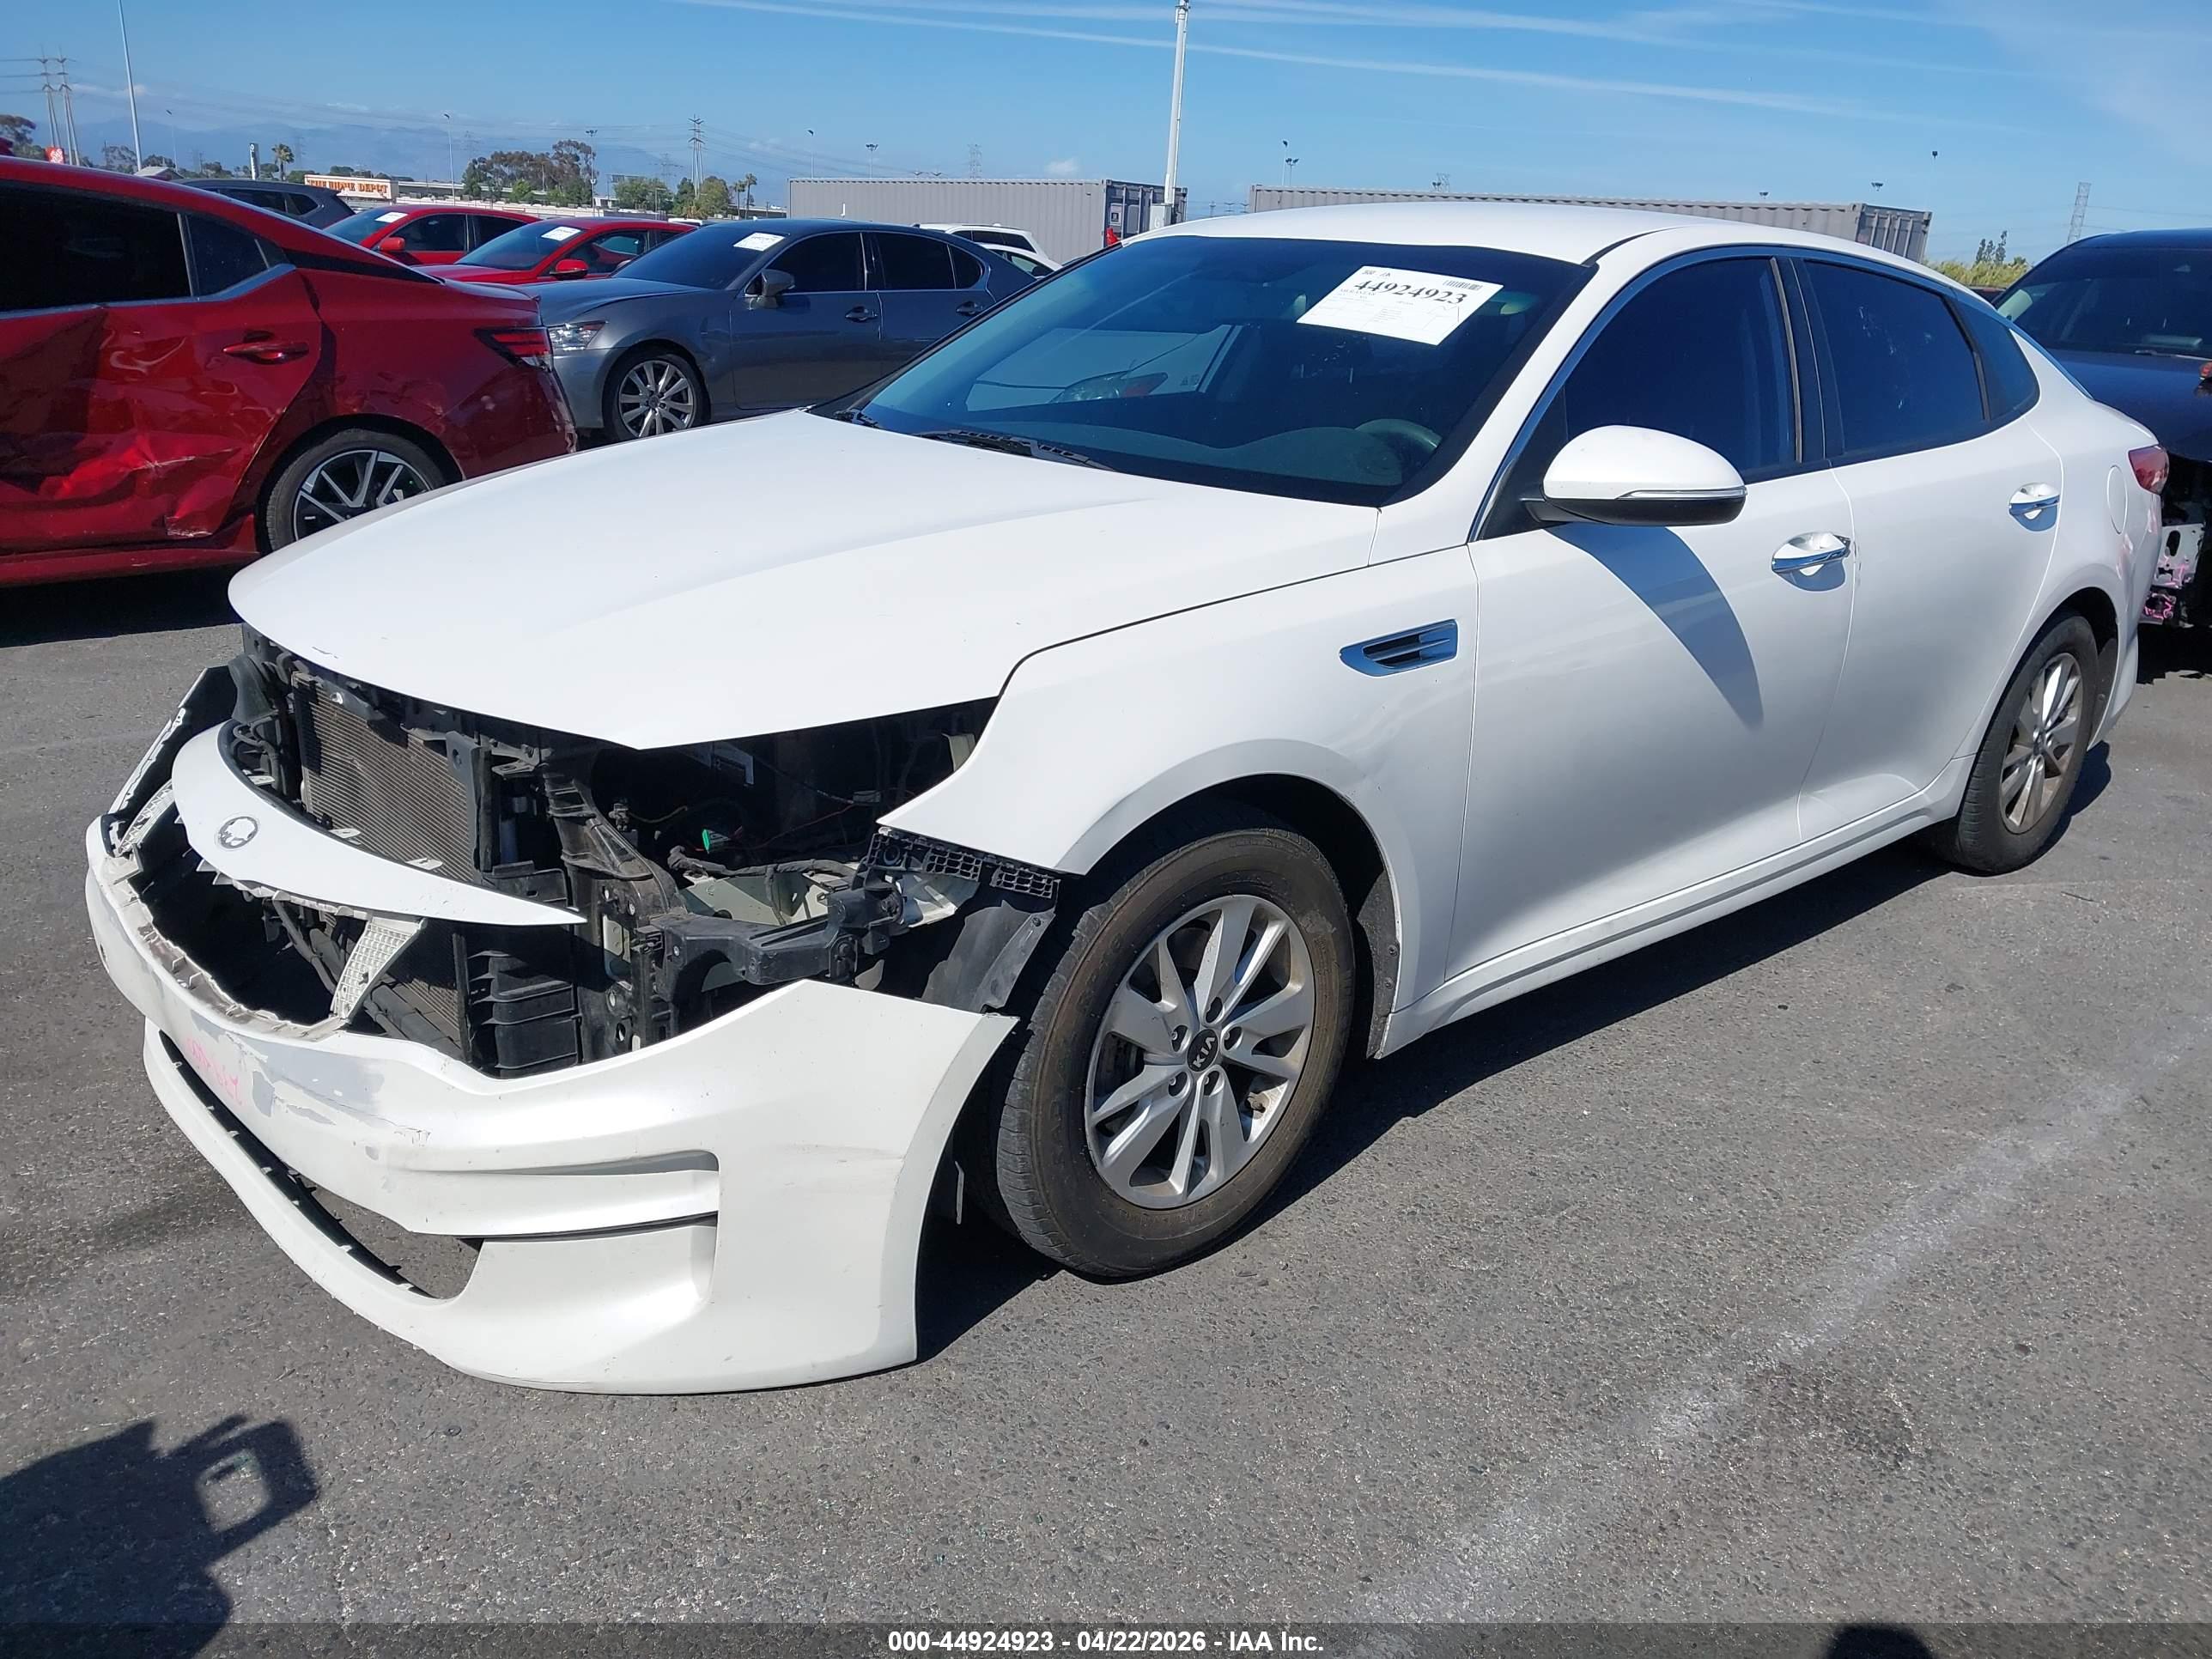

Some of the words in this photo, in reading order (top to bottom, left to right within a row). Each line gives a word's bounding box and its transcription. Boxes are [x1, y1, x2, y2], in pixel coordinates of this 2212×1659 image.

[329, 181, 356, 191] HOME
[357, 183, 388, 194] DEPOT
[1354, 280, 1468, 304] 44924923
[1193, 1036, 1215, 1067] KIA
